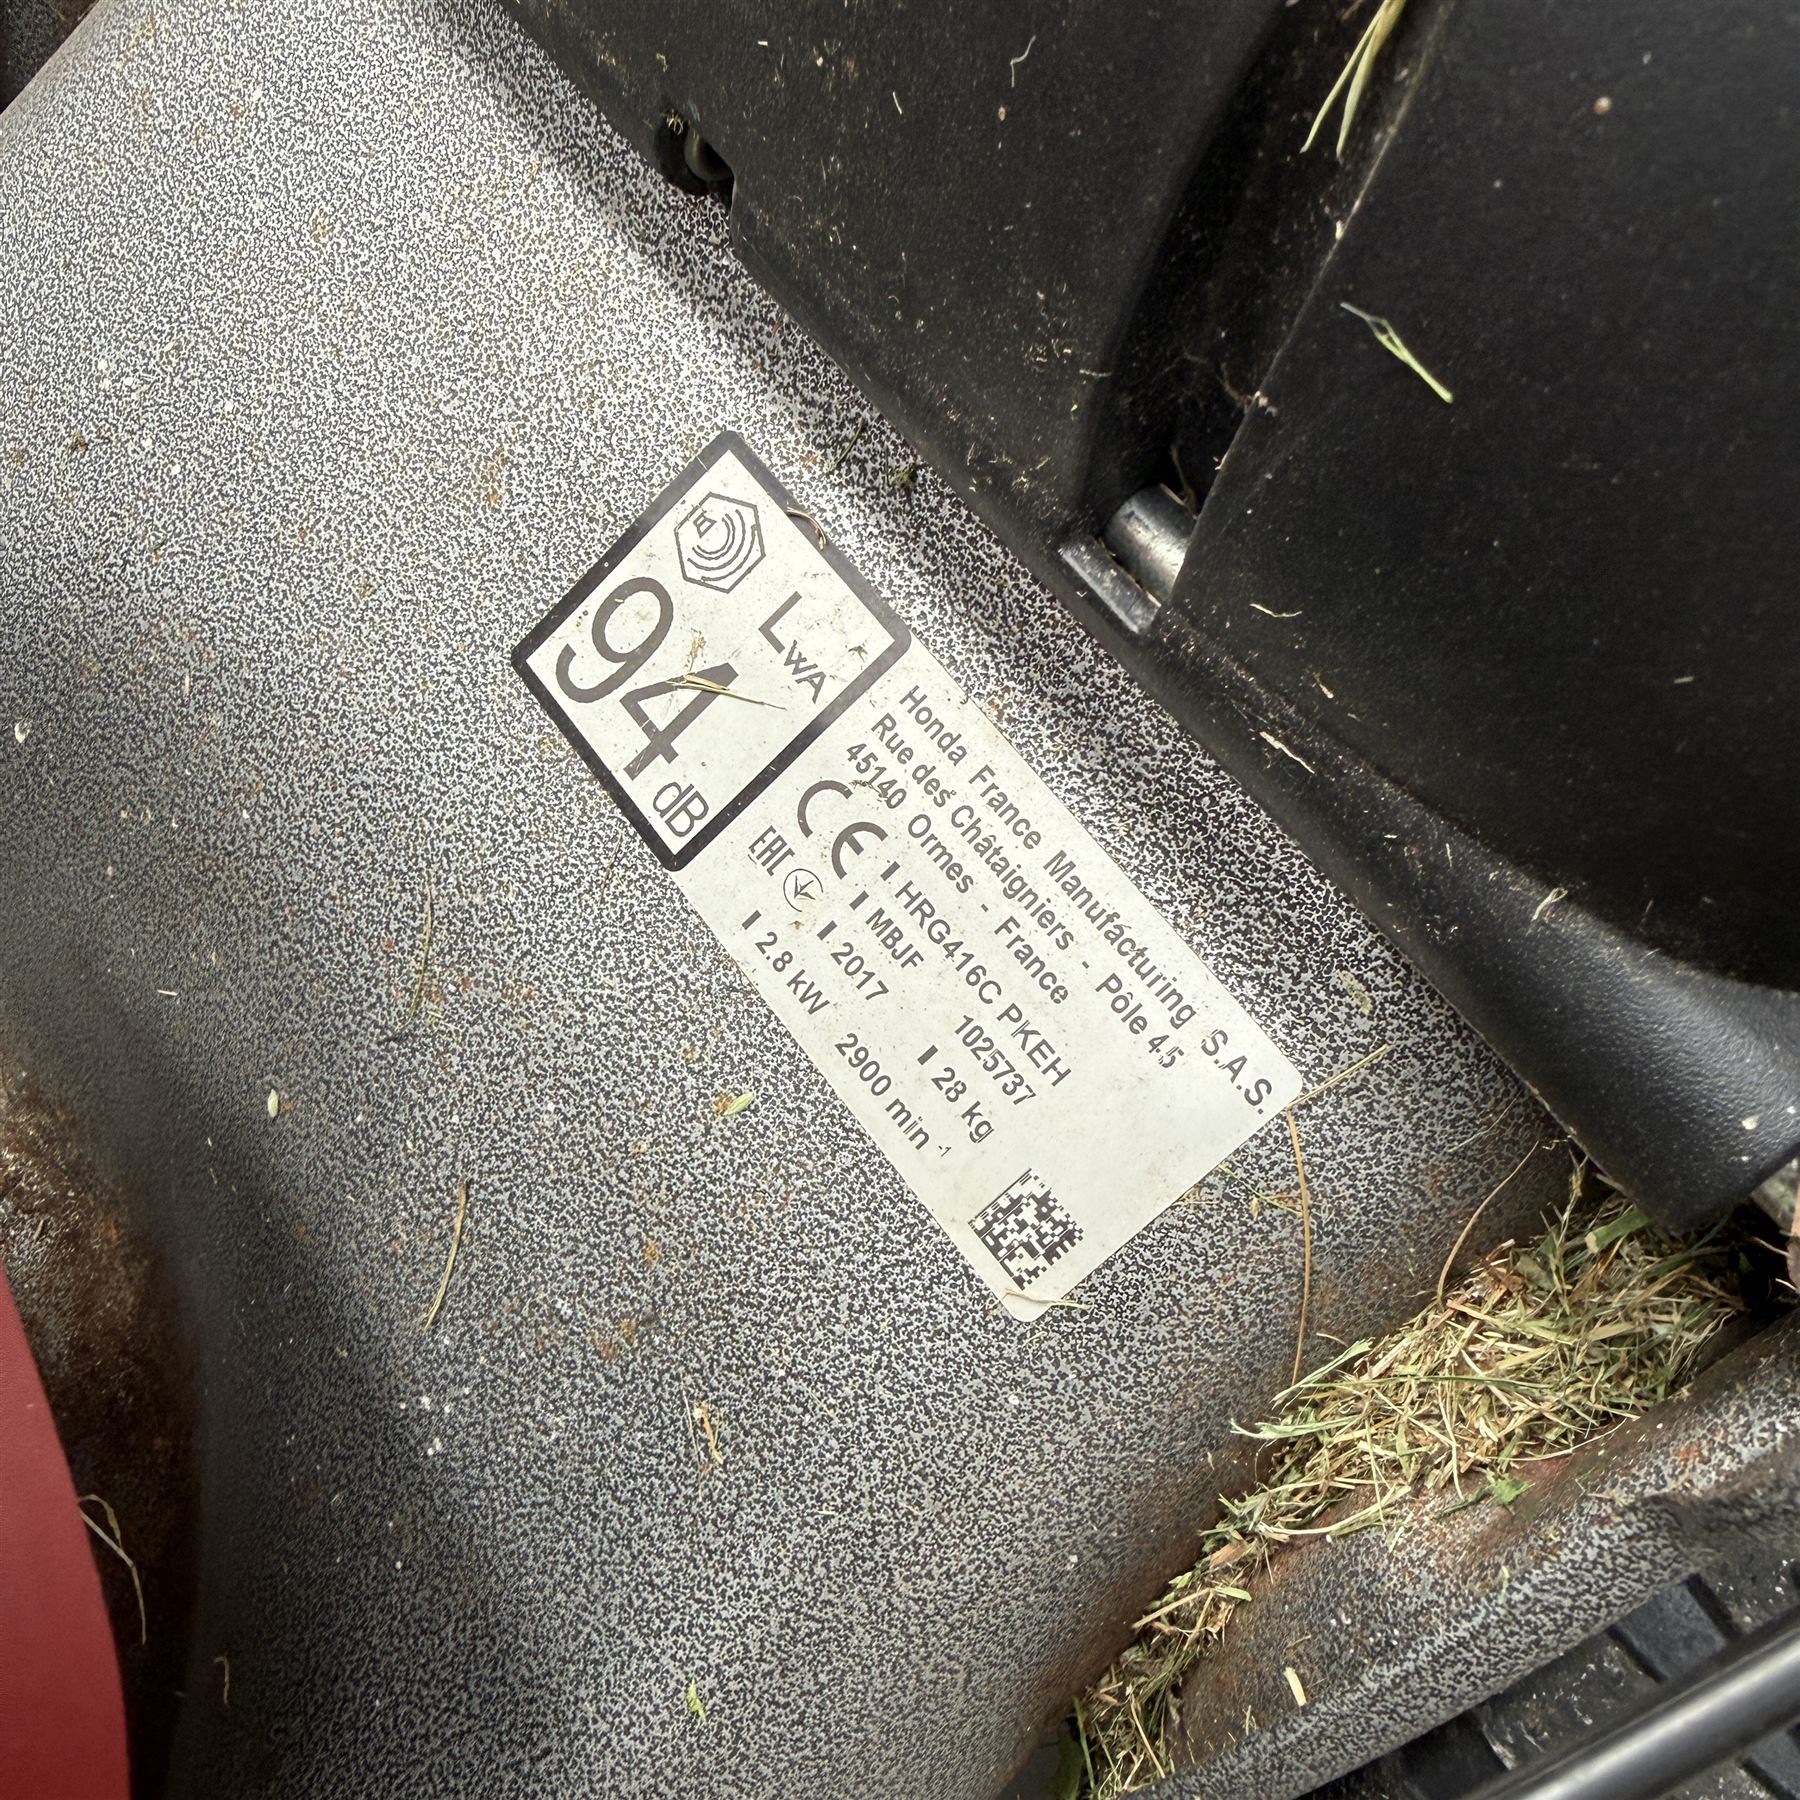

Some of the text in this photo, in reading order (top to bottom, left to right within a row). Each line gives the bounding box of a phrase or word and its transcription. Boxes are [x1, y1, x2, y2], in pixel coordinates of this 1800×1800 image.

[555, 576, 739, 782] 94
[652, 781, 709, 838] dB
[796, 779, 889, 880] CE
[846, 743, 907, 809] 45140
[907, 813, 974, 894] Ormes
[993, 915, 1069, 1004] France
[870, 712, 914, 765] Rue
[911, 763, 951, 808] des
[950, 804, 1074, 951] Châtaigniers
[1094, 972, 1148, 1035] Pôle
[1147, 1034, 1185, 1069] 45
[898, 684, 1273, 1115] Honda France Manufacturing S.A.S.
[754, 931, 794, 972] 2.8
[786, 968, 830, 1015] kW
[834, 1032, 892, 1097] 2900
[885, 1097, 930, 1151] min
[830, 941, 995, 1144] 2017 28 kg
[865, 907, 1037, 1105] MBJF 1025737
[894, 879, 1072, 1087] HRG416C PKEH
